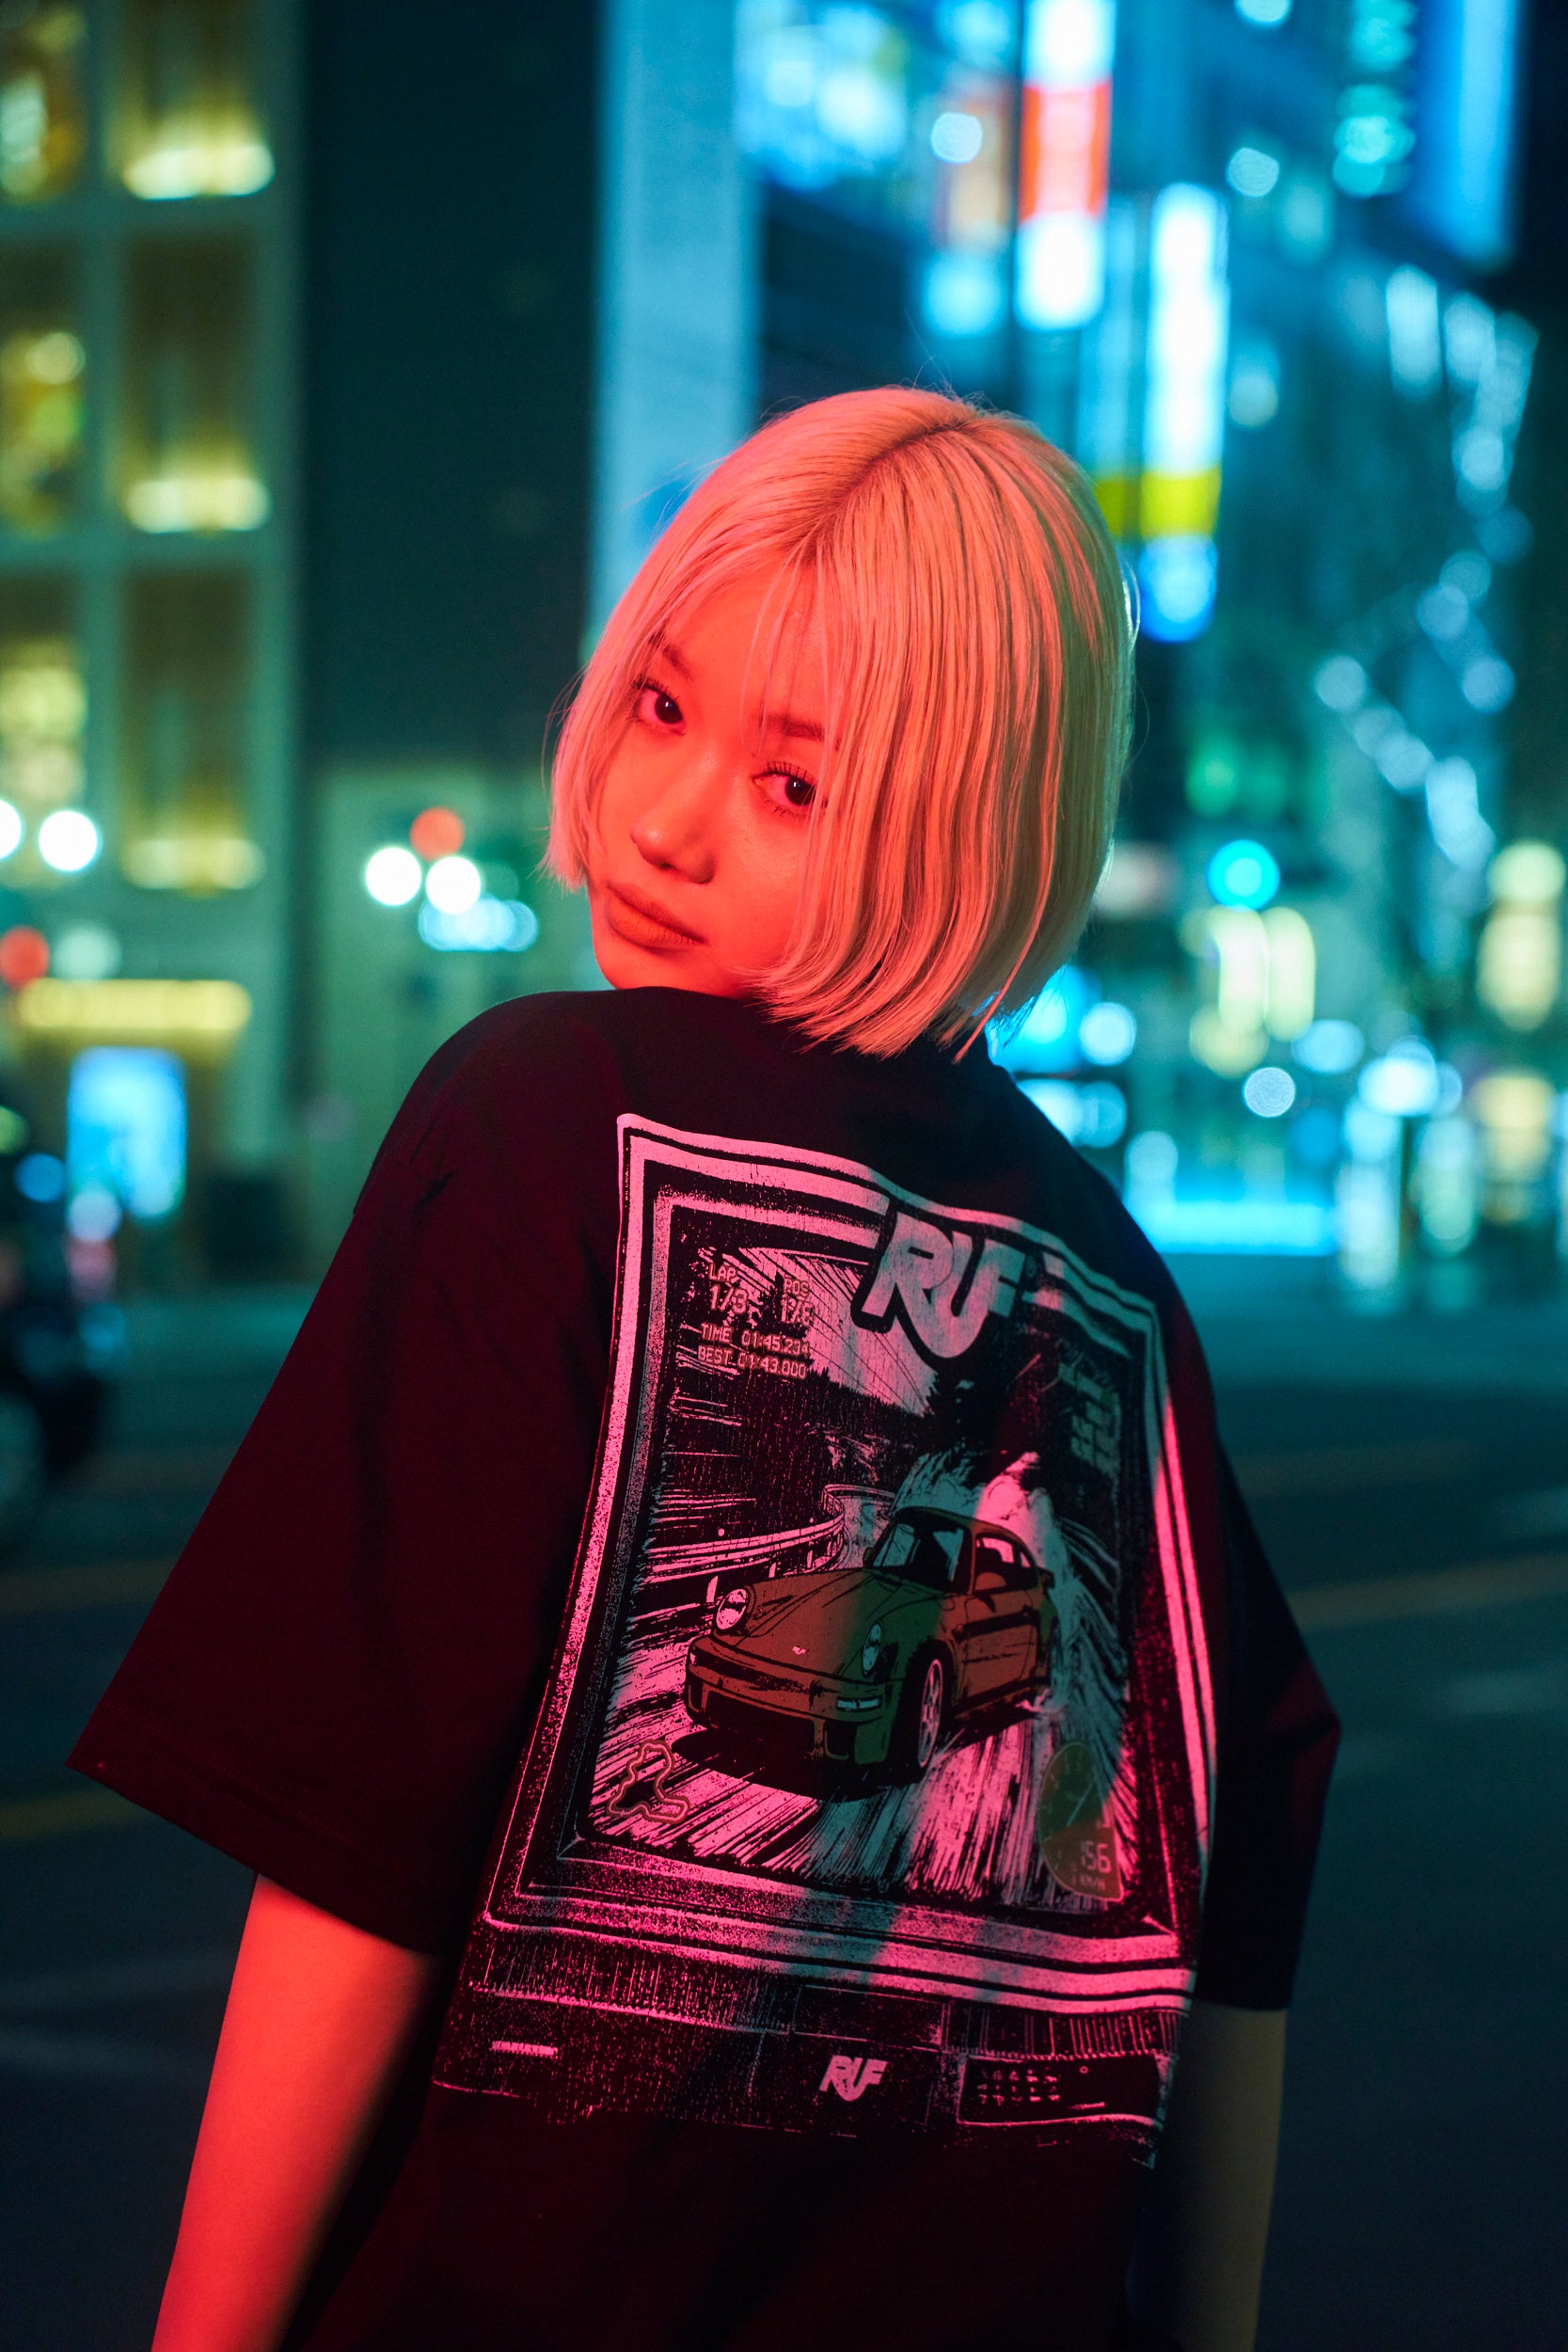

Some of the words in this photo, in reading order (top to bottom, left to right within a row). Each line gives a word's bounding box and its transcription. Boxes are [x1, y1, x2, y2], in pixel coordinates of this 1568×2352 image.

[708, 1263, 736, 1283] LAP
[784, 1278, 810, 1297] POS
[861, 1211, 1026, 1359] RUF
[709, 1284, 749, 1314] 1/3
[698, 1345, 733, 1366] BEST
[701, 1323, 733, 1343] TIME
[741, 1330, 810, 1358] 01:45.234
[818, 2055, 888, 2102] RUF
